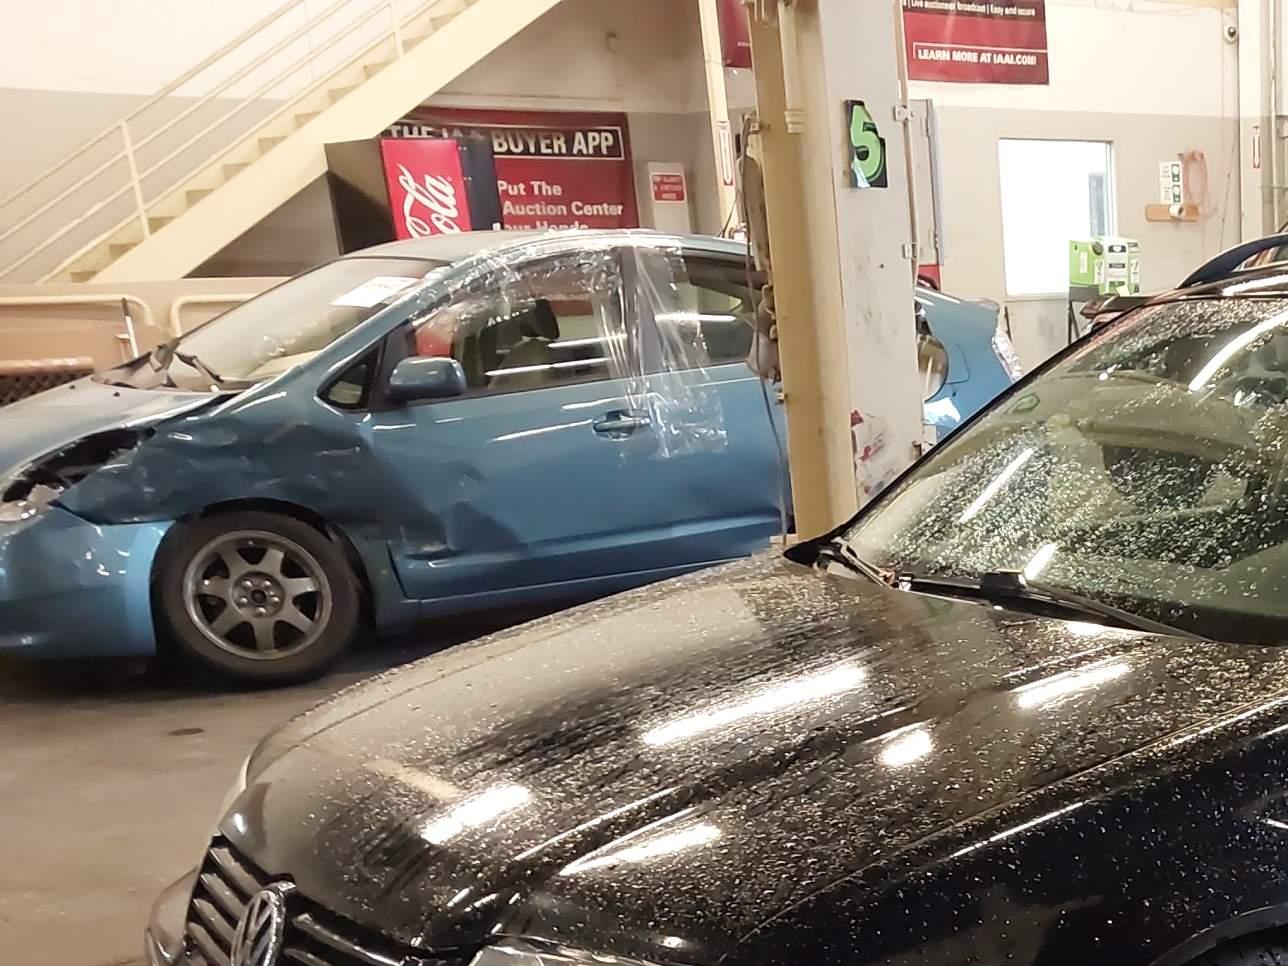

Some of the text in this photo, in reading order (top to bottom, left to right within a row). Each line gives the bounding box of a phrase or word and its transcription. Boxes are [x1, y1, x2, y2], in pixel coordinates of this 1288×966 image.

[918, 49, 950, 61] LEARN
[952, 51, 977, 63] MORE
[980, 54, 991, 64] AT
[492, 130, 567, 154] BUYER
[572, 132, 614, 155] APP
[849, 104, 882, 180] 5
[497, 180, 562, 196] Put The
[503, 201, 625, 216] Auction Center
